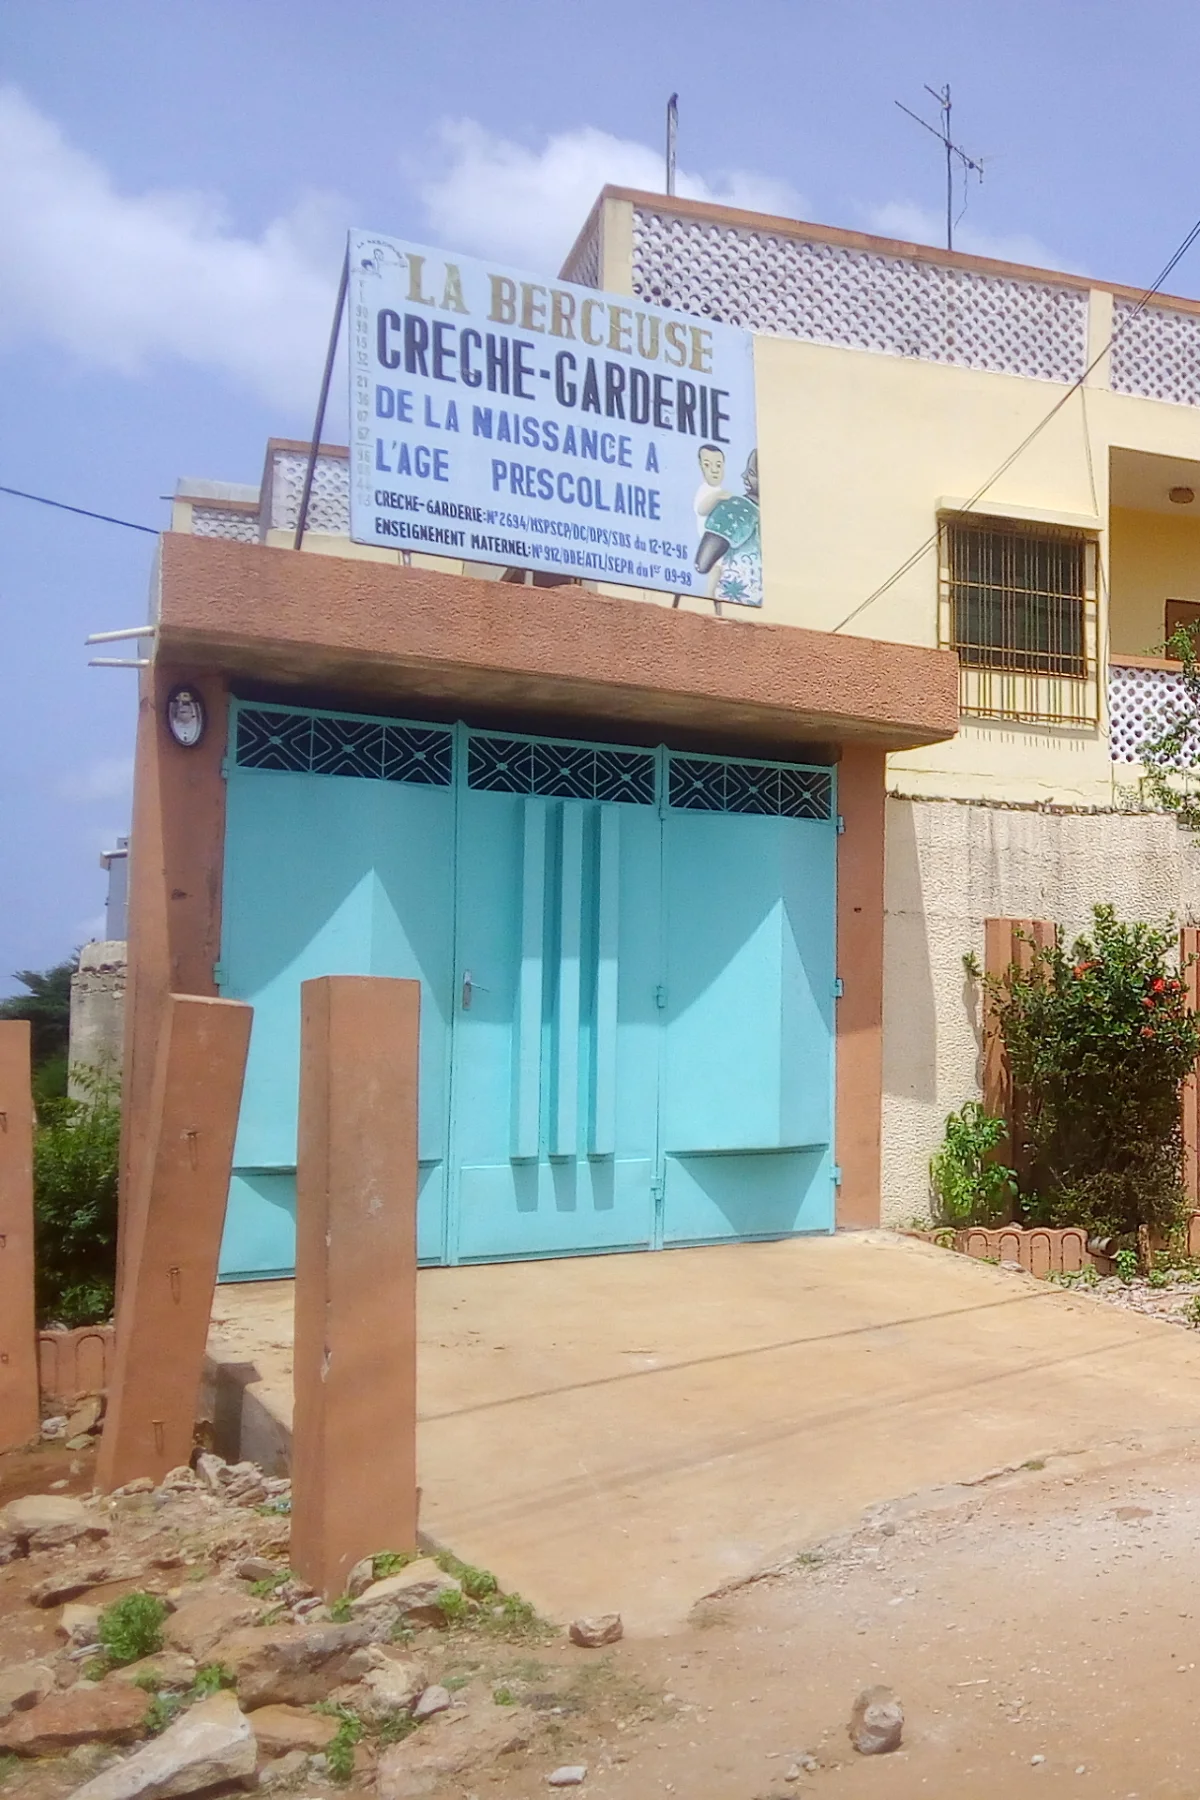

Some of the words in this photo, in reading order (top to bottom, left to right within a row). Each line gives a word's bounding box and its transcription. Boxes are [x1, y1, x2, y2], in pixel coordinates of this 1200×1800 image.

[404, 252, 471, 315] LA
[486, 272, 713, 375] BERCEUSE
[377, 308, 731, 444] CRECHE-GARDERIE
[375, 384, 413, 424] DE
[424, 394, 460, 433] LA
[472, 405, 633, 468] NAISSANCE
[645, 441, 660, 474] A
[375, 437, 449, 482] L'AGE
[491, 458, 661, 521] PRESCOLAIRE
[375, 517, 466, 547] ENSEIGNEMENT
